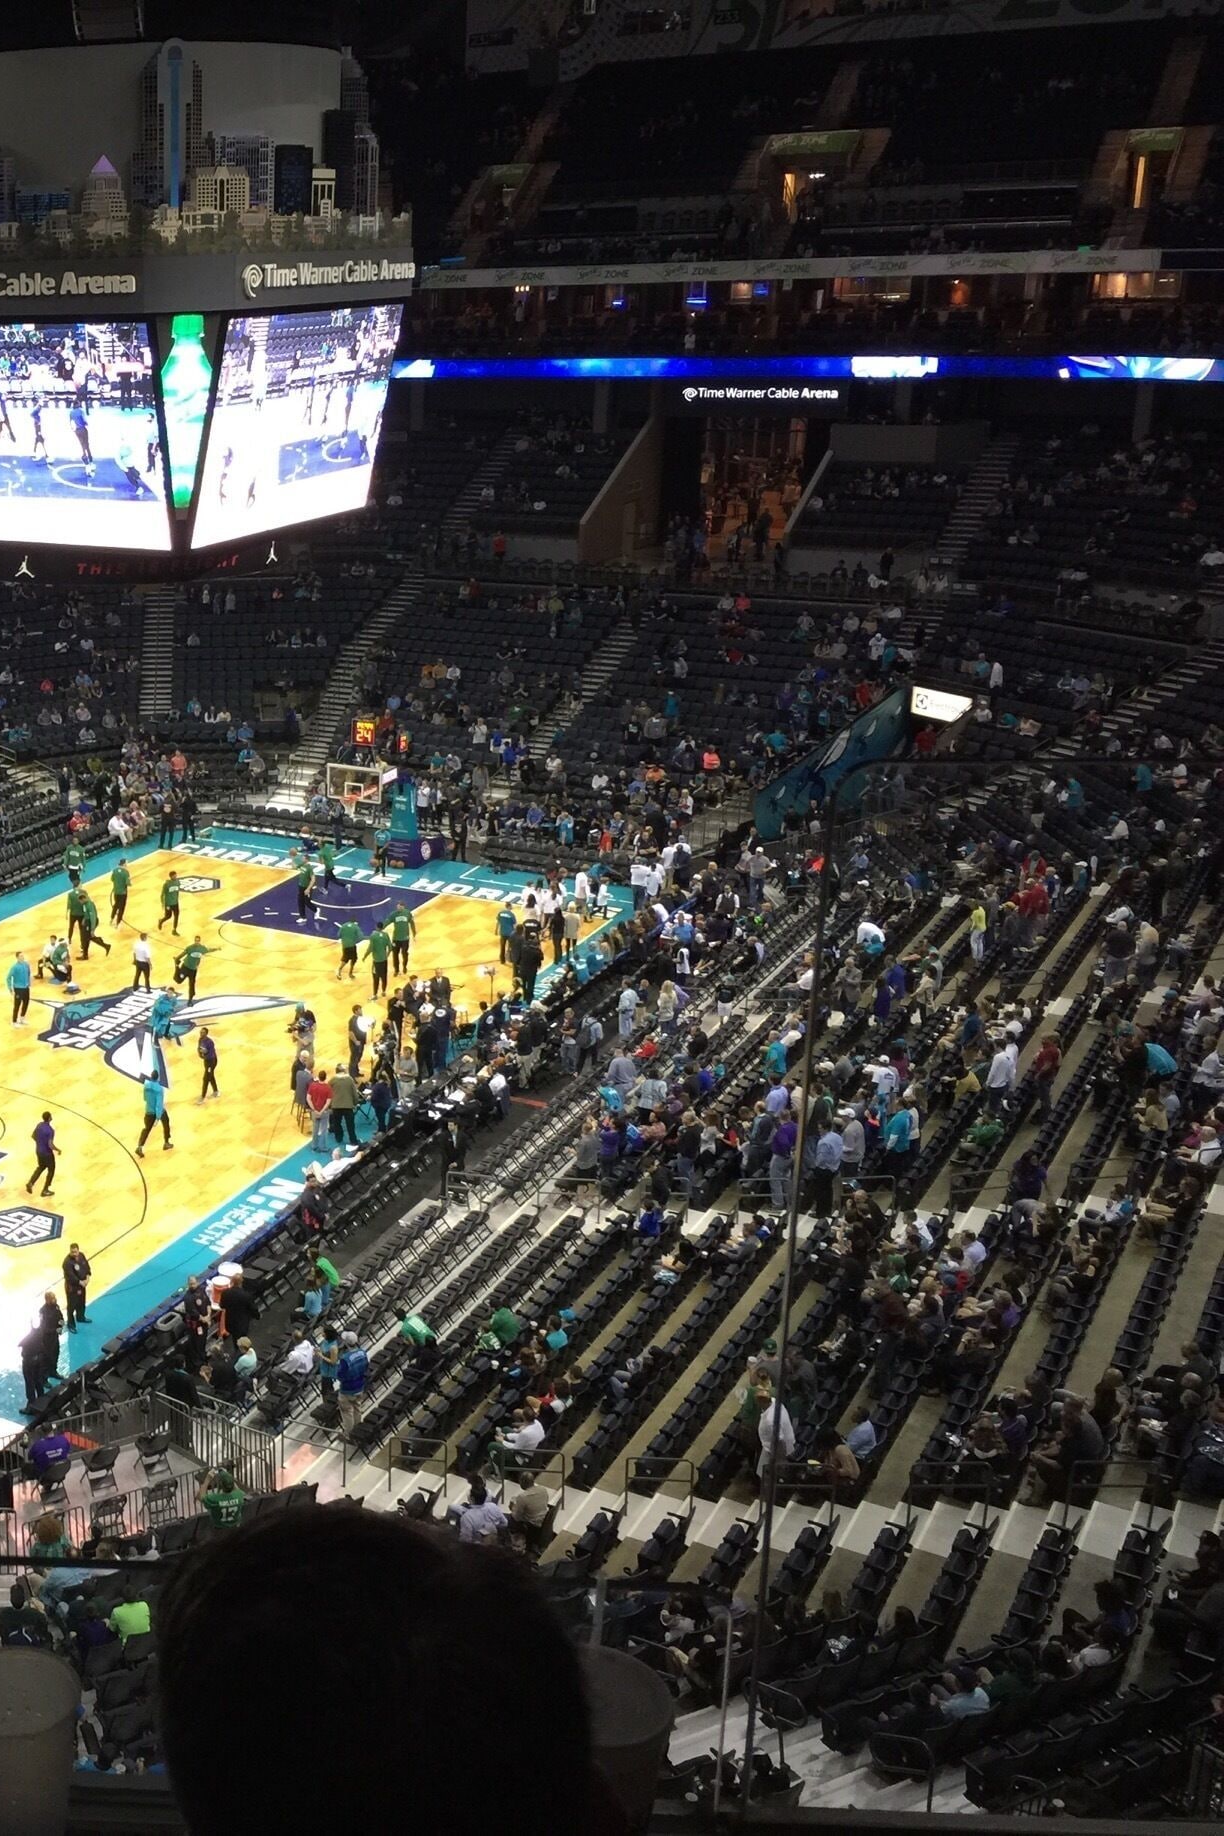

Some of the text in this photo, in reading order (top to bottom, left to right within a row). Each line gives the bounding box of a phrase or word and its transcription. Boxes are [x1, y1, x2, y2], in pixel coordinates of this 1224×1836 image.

[59, 271, 137, 296] Arena
[263, 263, 298, 288] Time
[296, 262, 344, 286] Warner
[343, 260, 378, 283] Cable
[378, 259, 416, 281] Arena
[697, 387, 839, 400] Time Warner Cable Arena
[356, 729, 372, 742] 24
[4, 1214, 53, 1243] BUZZ
[192, 1204, 256, 1246] HEALTH
